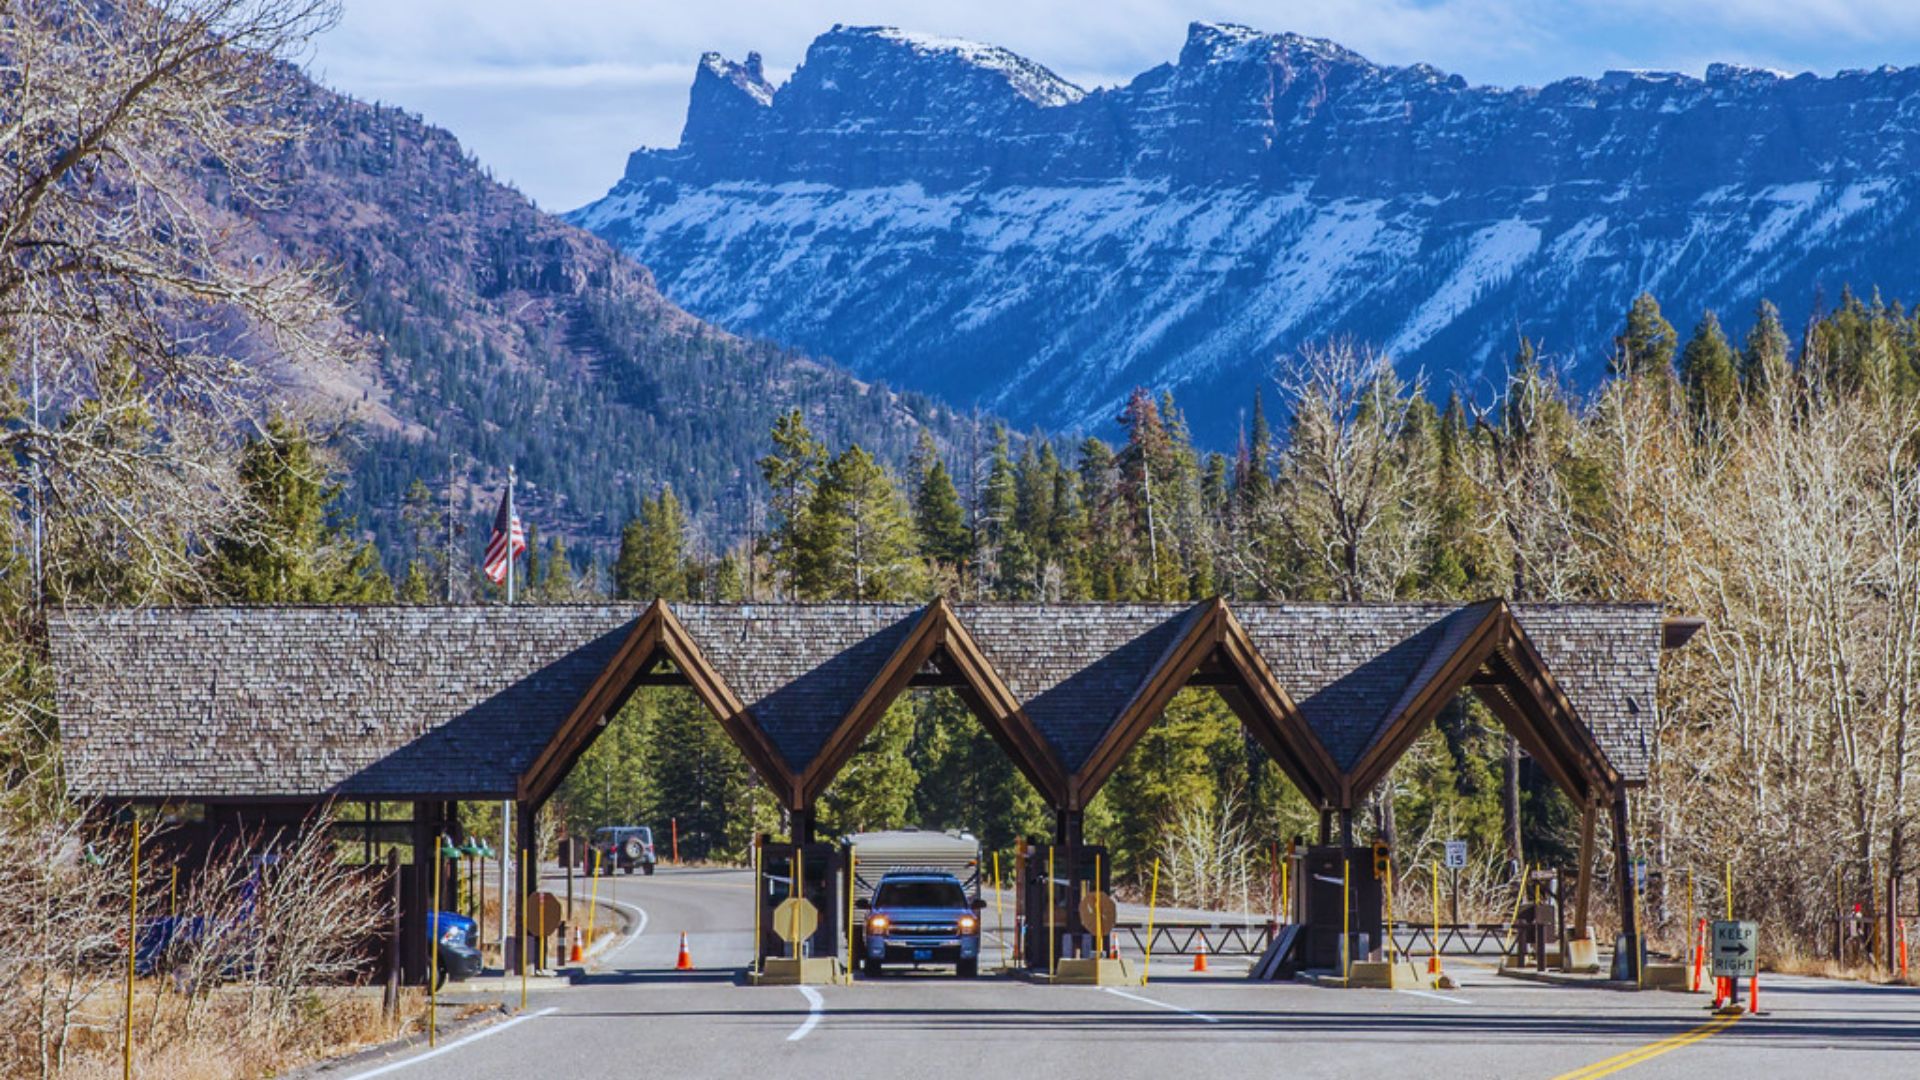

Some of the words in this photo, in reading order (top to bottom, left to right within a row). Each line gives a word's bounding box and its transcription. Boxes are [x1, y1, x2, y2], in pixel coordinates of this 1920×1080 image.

[1451, 855, 1463, 865] 15
[1718, 928, 1752, 940] KEEP
[1716, 959, 1753, 970] RIGHT
